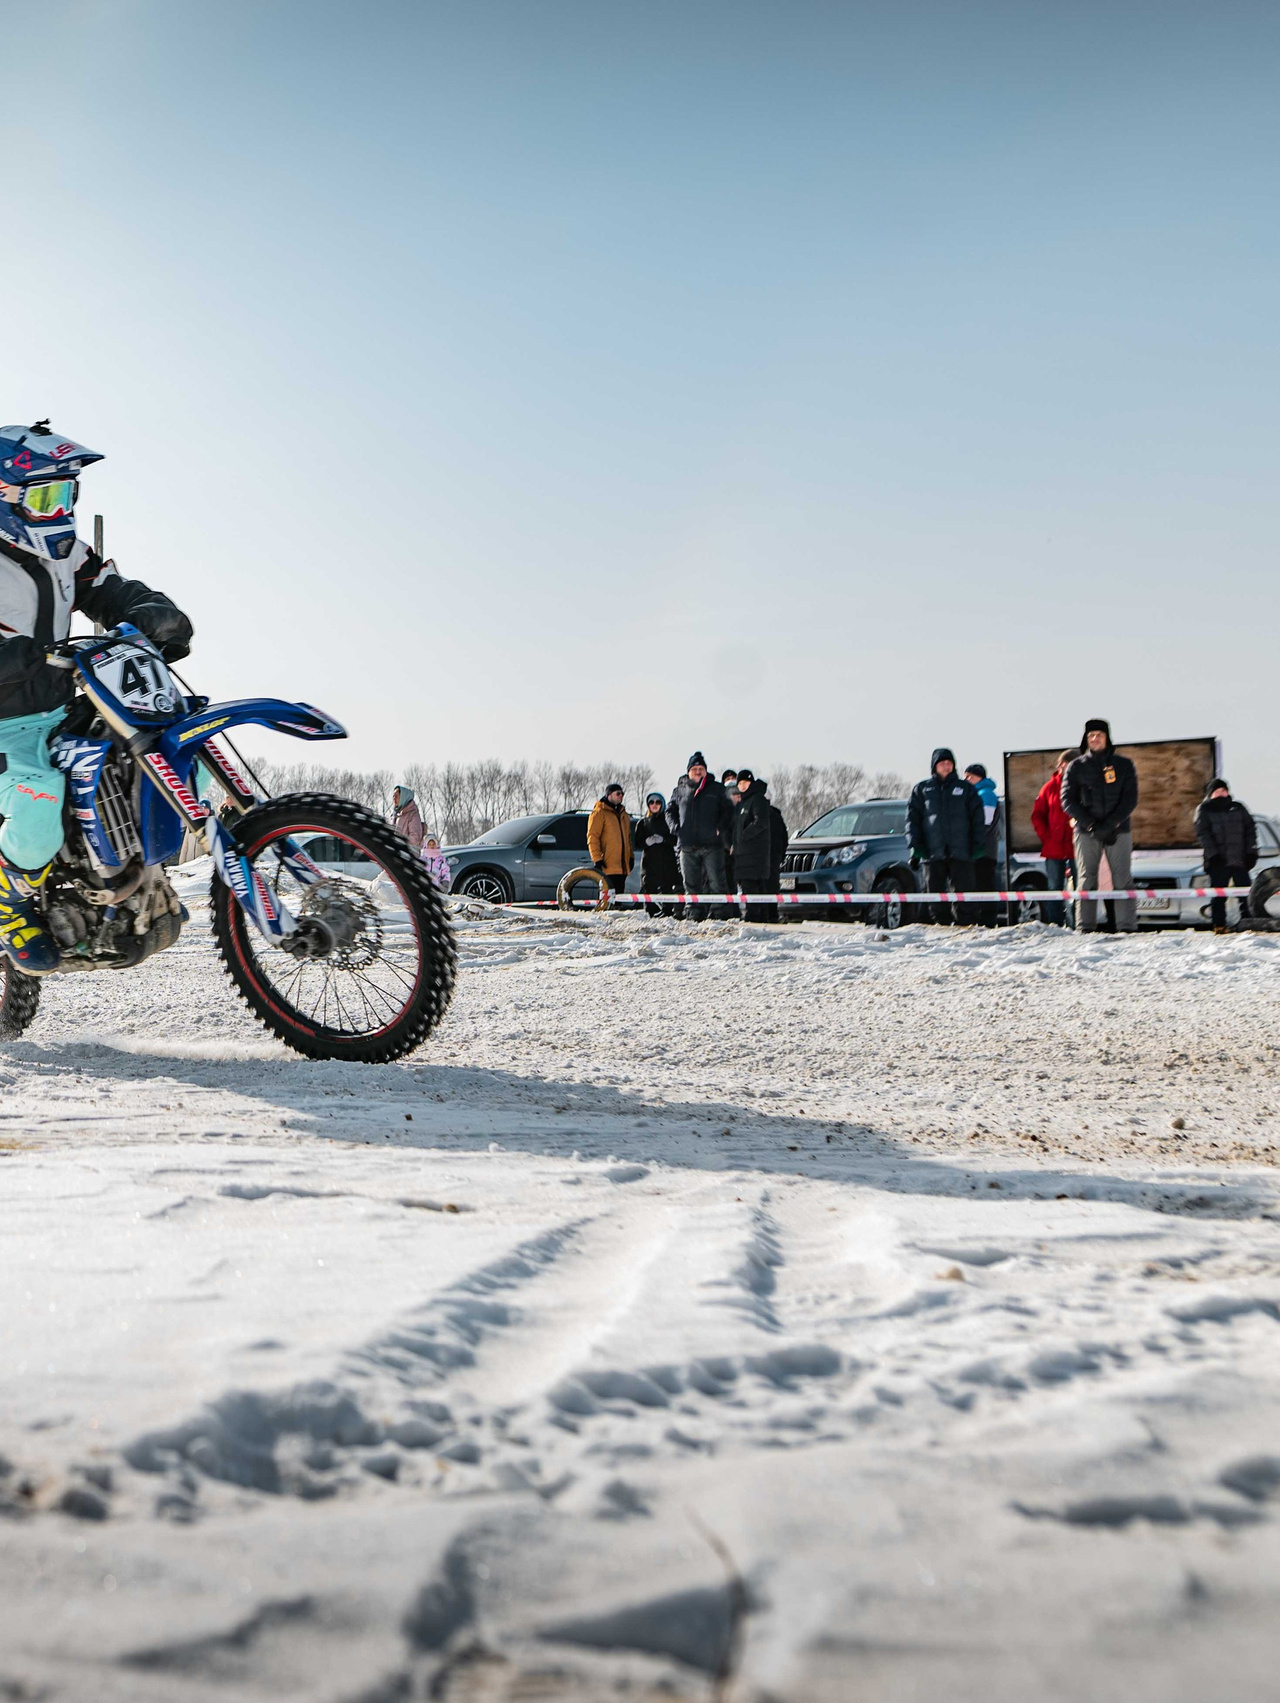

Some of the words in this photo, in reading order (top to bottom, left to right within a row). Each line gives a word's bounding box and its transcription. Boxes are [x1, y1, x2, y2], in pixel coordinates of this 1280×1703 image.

[120, 652, 165, 699] 47
[143, 752, 208, 821] SHOWA
[224, 849, 250, 899] YAMAHA
